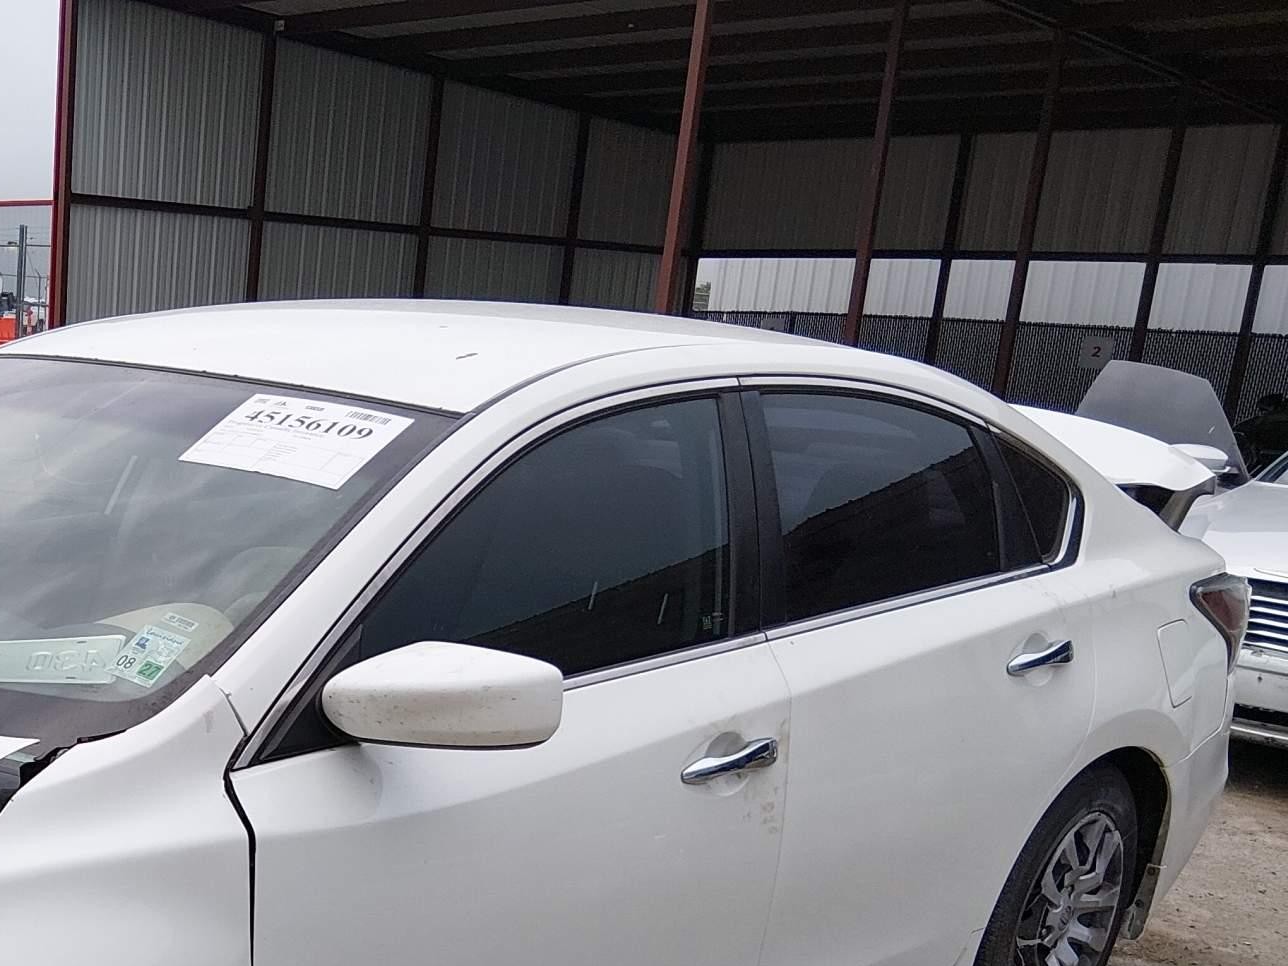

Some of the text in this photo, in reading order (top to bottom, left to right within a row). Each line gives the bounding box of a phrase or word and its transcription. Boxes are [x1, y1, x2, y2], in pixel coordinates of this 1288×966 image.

[1091, 346, 1102, 358] 2
[245, 410, 373, 439] 45156109
[116, 654, 137, 669] 08
[137, 663, 164, 677] 27
